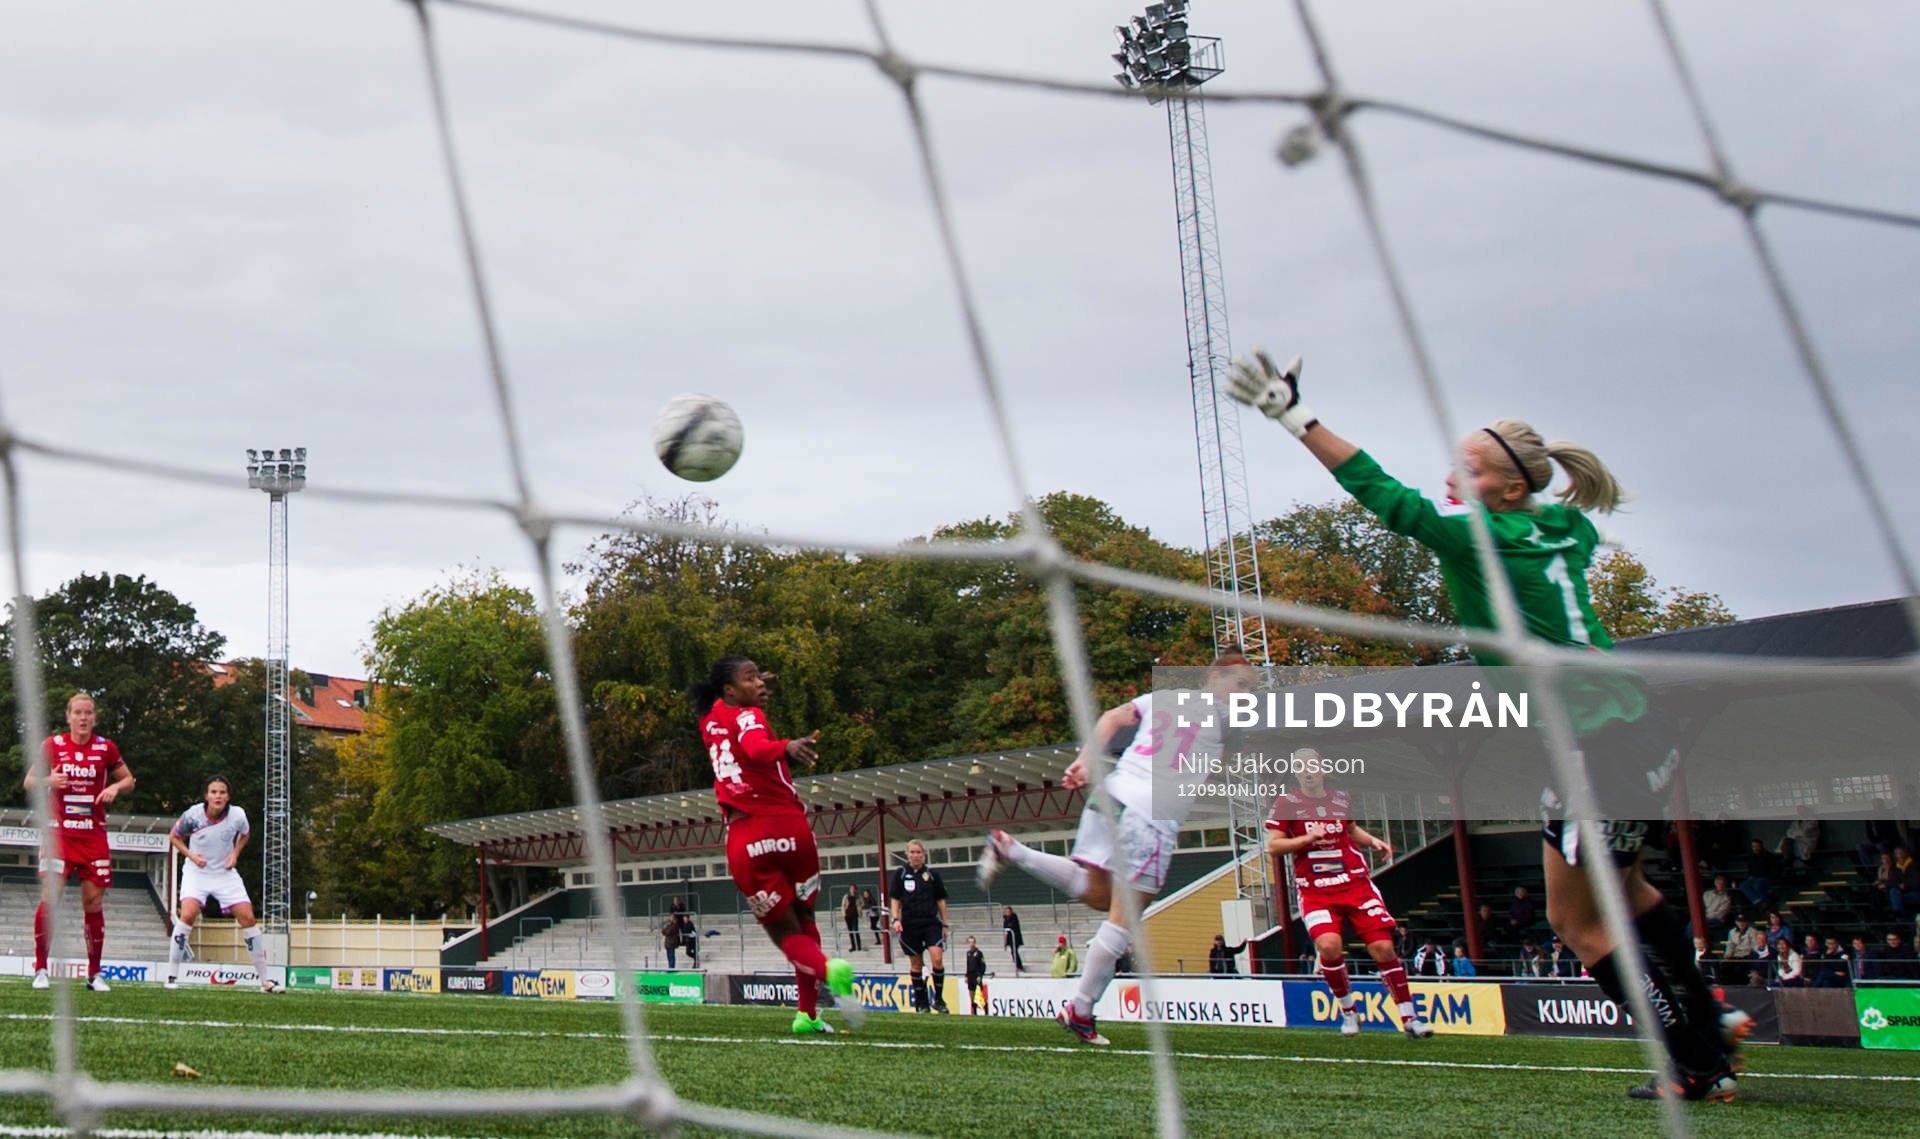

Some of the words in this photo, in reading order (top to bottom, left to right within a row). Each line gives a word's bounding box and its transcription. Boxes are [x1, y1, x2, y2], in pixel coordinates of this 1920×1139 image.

[1544, 552, 1590, 645] 1
[62, 763, 97, 778] Piteå
[709, 739, 743, 783] 14
[0, 827, 38, 841] LIFFTON
[116, 834, 164, 847] CLIFFTON
[186, 969, 211, 978] PRO
[217, 971, 260, 981] TOUCH
[512, 974, 540, 995] DÄCK
[540, 977, 566, 995] TEAM
[743, 984, 775, 1000] KUMHO
[776, 984, 800, 1001] TYRE
[852, 978, 894, 1007] DÄCK
[992, 998, 1056, 1018] SVENSKA
[1146, 1001, 1223, 1022] SVENSKA
[1230, 1003, 1273, 1024] SPEL
[1311, 990, 1385, 1023] DCK
[1411, 993, 1472, 1025] EAM
[1538, 999, 1619, 1026] KUMHO
[1886, 1014, 1920, 1027] SPAR
